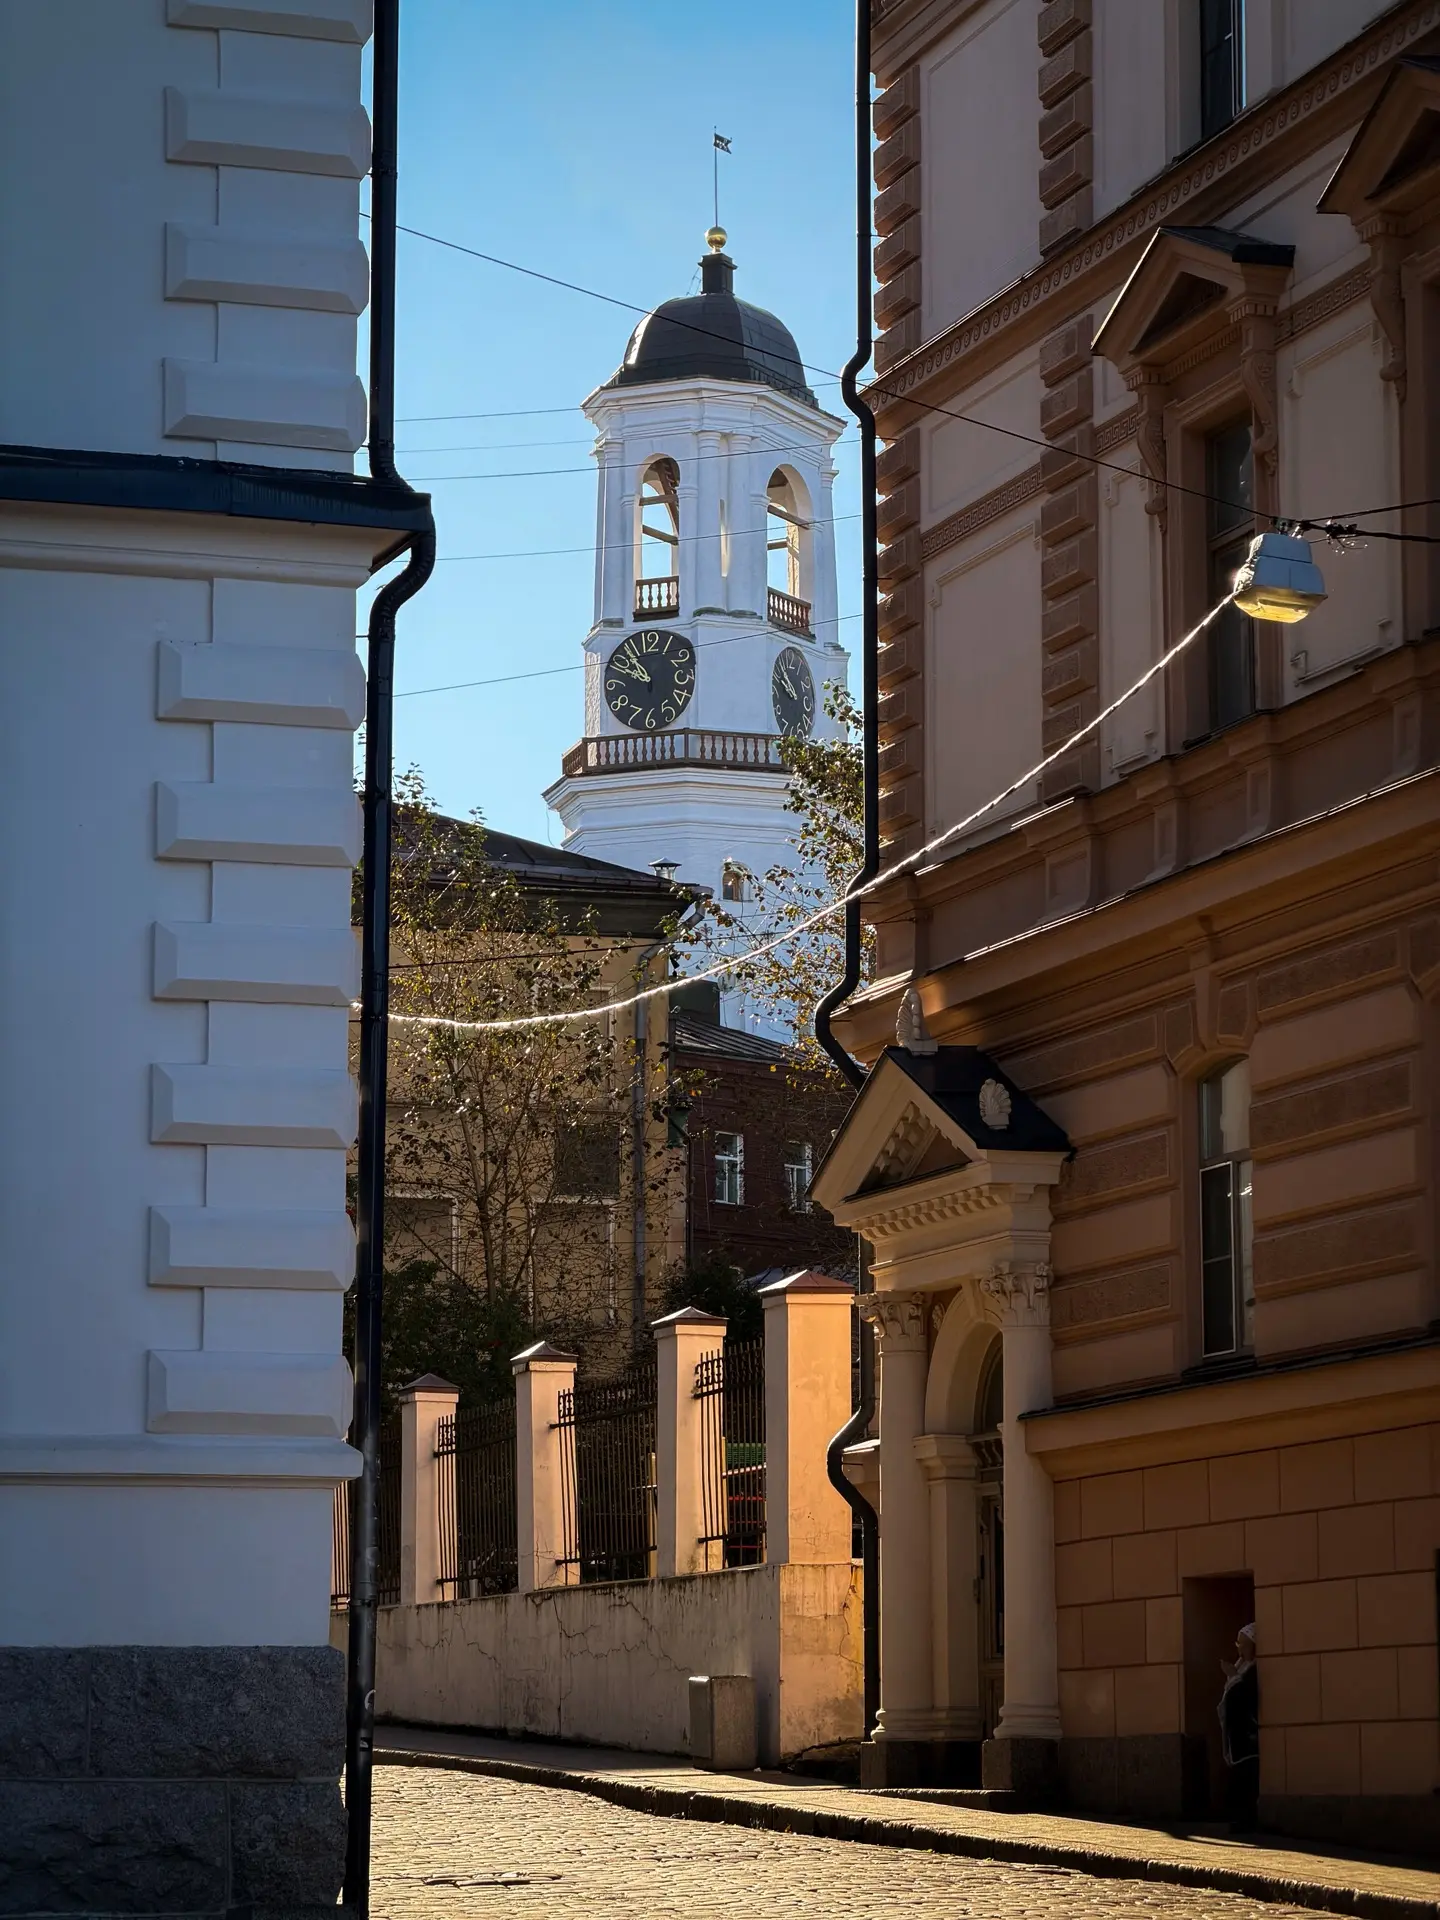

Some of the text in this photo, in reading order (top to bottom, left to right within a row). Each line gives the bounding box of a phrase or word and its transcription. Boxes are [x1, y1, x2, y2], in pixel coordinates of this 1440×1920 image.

[641, 632, 659, 653] 12
[662, 635, 673, 655] 1
[610, 654, 630, 674] 10
[670, 648, 690, 668] 2
[606, 679, 626, 691] 9
[674, 669, 695, 685] 3
[610, 694, 629, 711] 8
[673, 688, 691, 706] 4
[628, 704, 643, 726] 7
[645, 708, 656, 729] 6
[661, 699, 676, 722] 5
